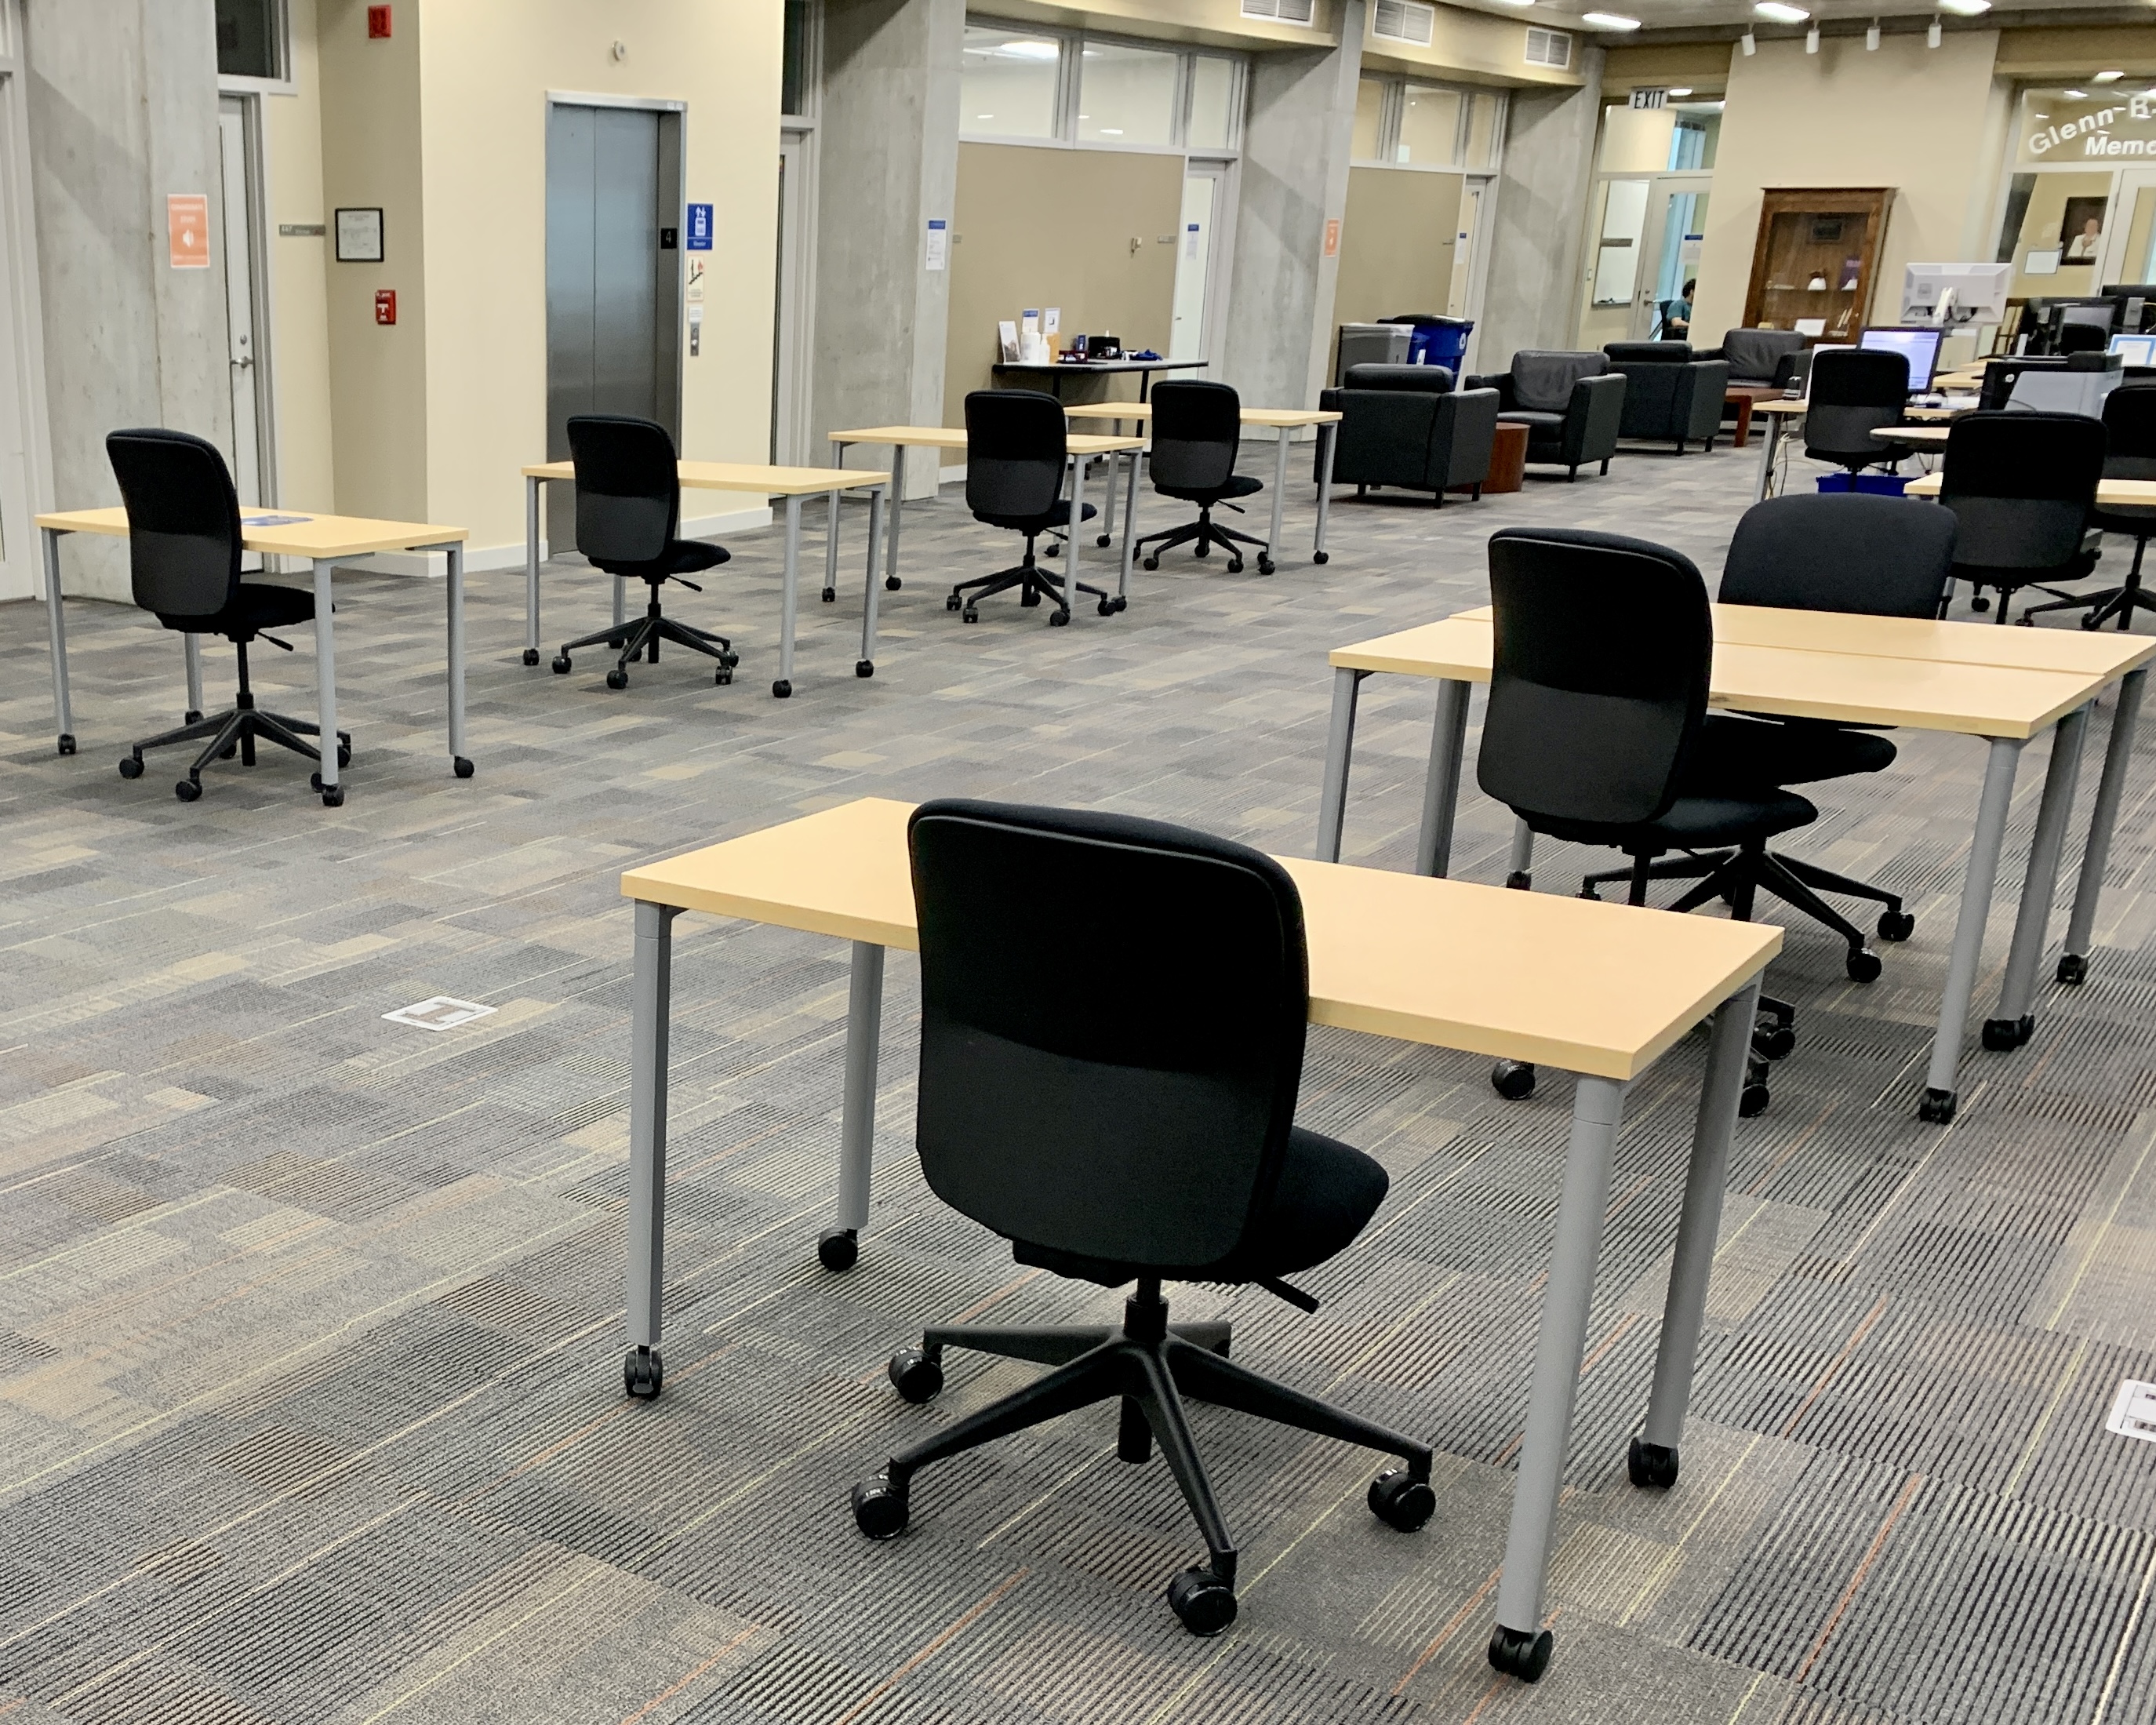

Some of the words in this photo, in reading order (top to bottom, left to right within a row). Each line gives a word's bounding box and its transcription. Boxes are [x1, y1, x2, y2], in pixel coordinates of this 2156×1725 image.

[1634, 90, 1664, 108] EXIT
[2029, 108, 2114, 155] Glenn
[665, 231, 671, 243] 4
